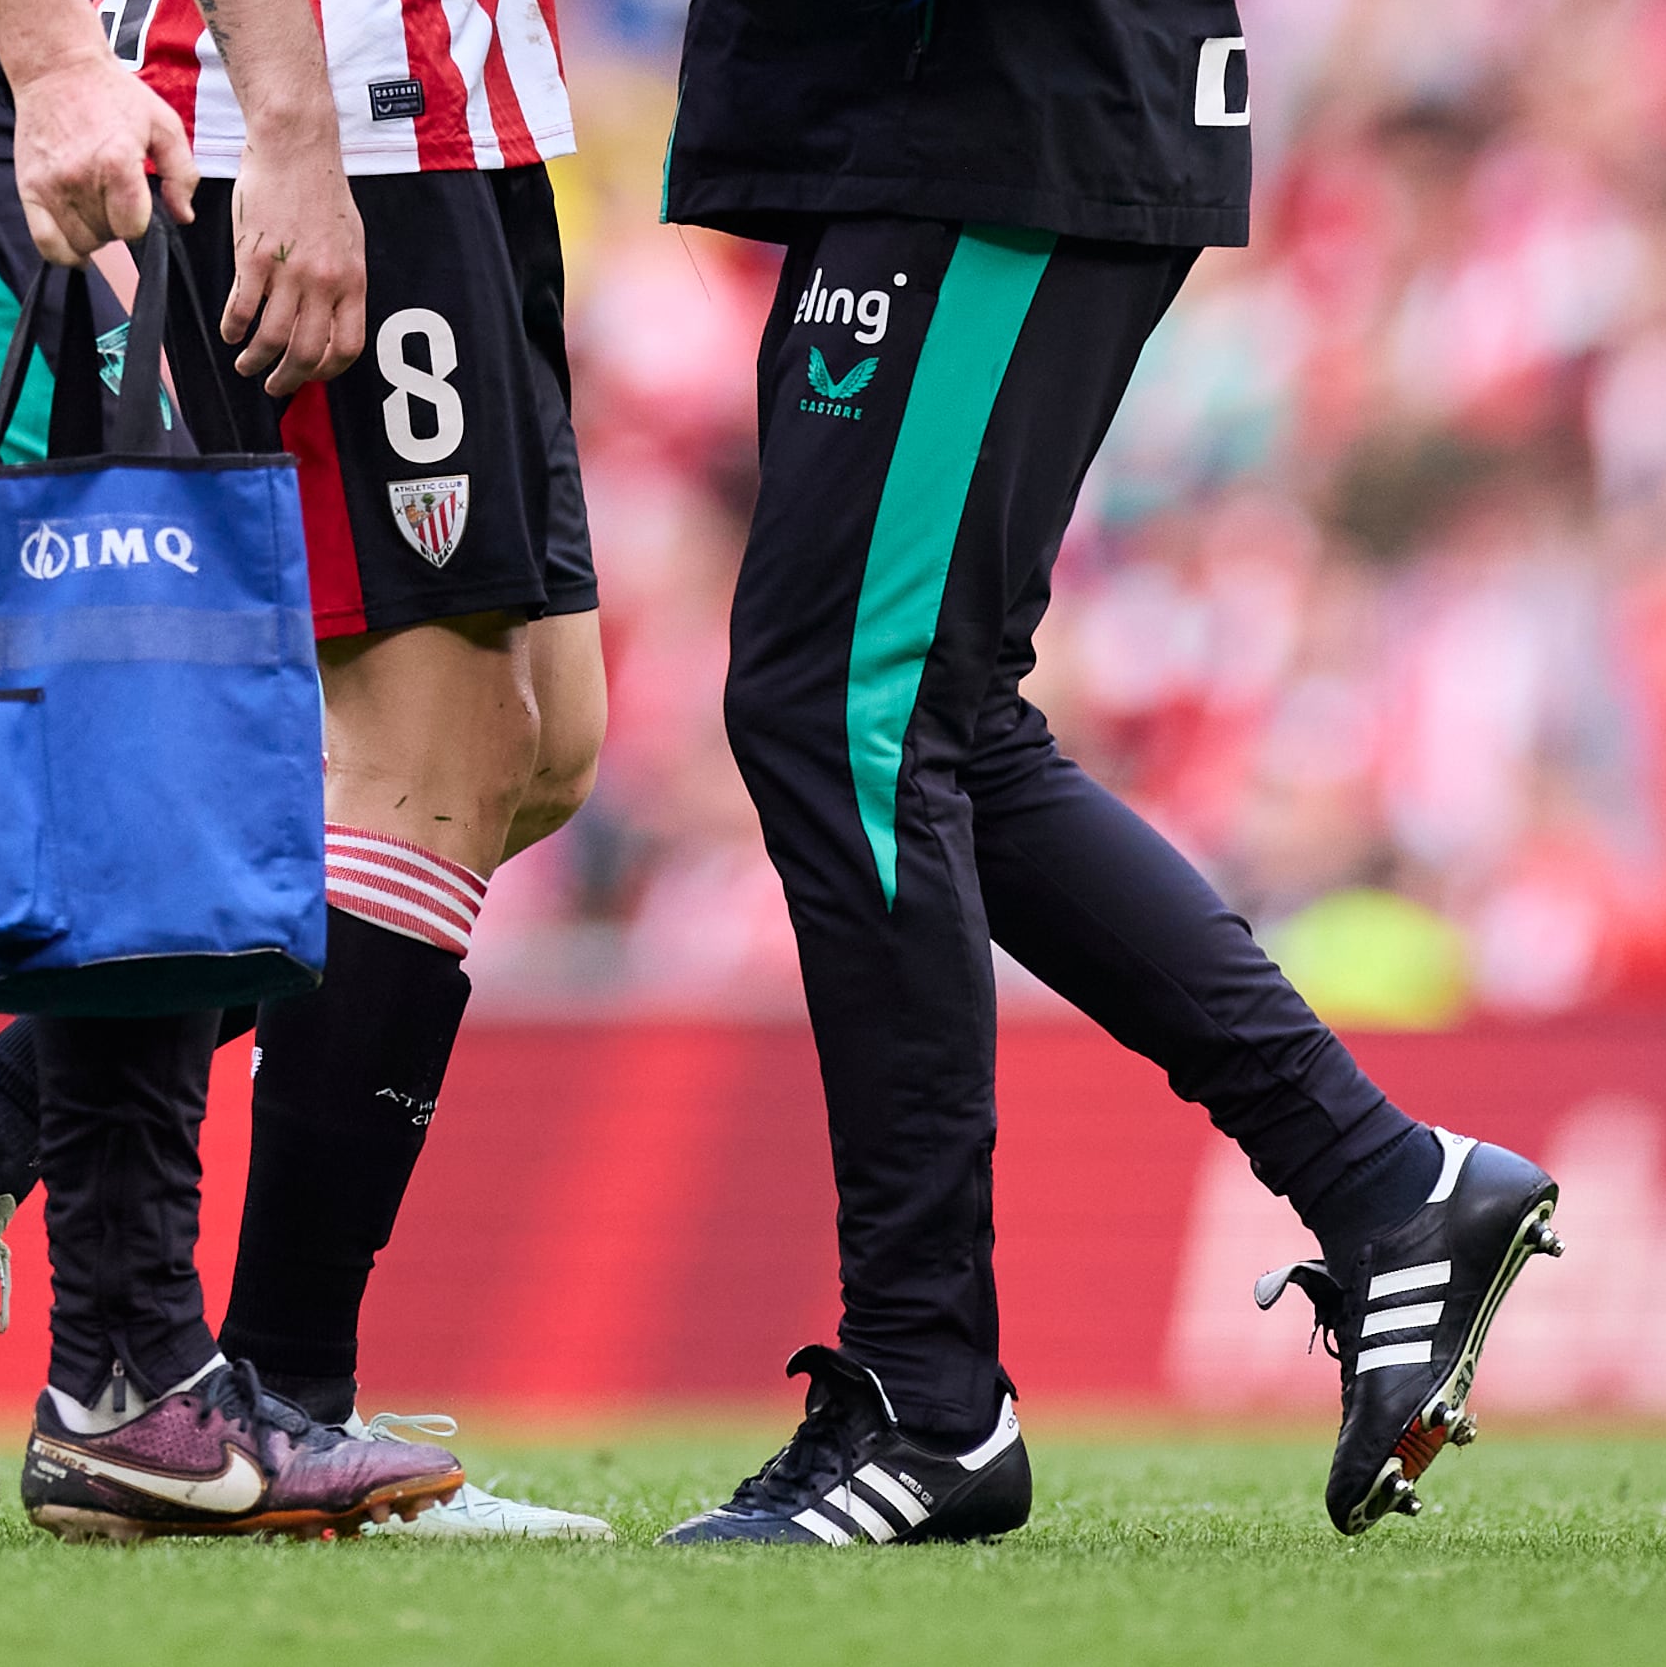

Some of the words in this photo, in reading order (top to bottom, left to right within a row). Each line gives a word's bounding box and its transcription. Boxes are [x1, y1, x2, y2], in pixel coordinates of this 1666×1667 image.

[376, 308, 464, 464] 8
[799, 399, 863, 420] CASTORE
[394, 482, 435, 493] ATHLETIC
[438, 481, 462, 489] CLUB
[73, 527, 199, 574] IMQ
